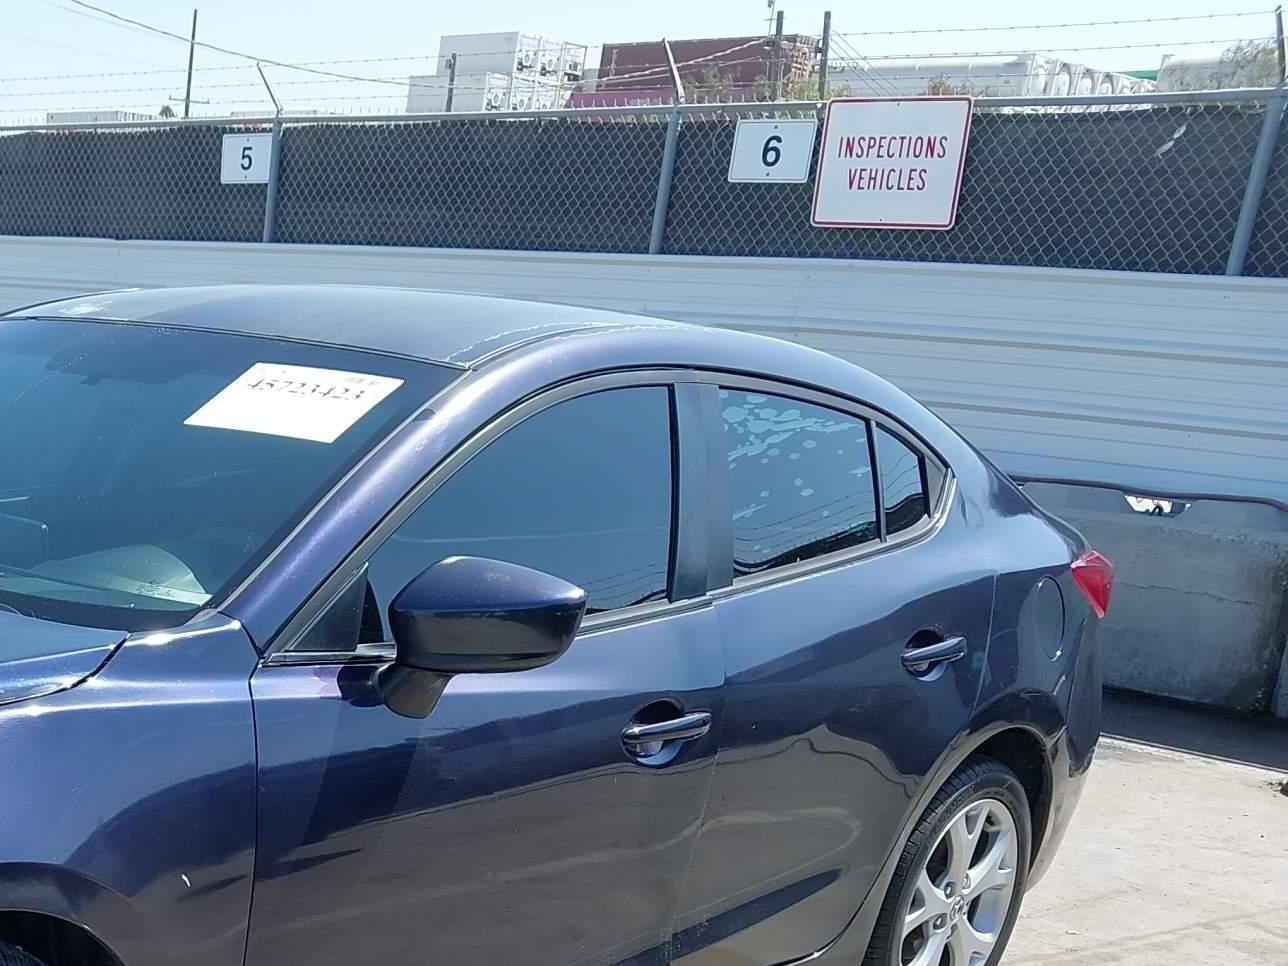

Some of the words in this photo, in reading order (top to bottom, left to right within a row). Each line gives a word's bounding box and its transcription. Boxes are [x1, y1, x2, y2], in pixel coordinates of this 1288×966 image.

[240, 146, 253, 171] 5
[760, 134, 783, 168] 6
[837, 135, 949, 159] INSPECTIONS
[847, 167, 928, 191] VEHICLES
